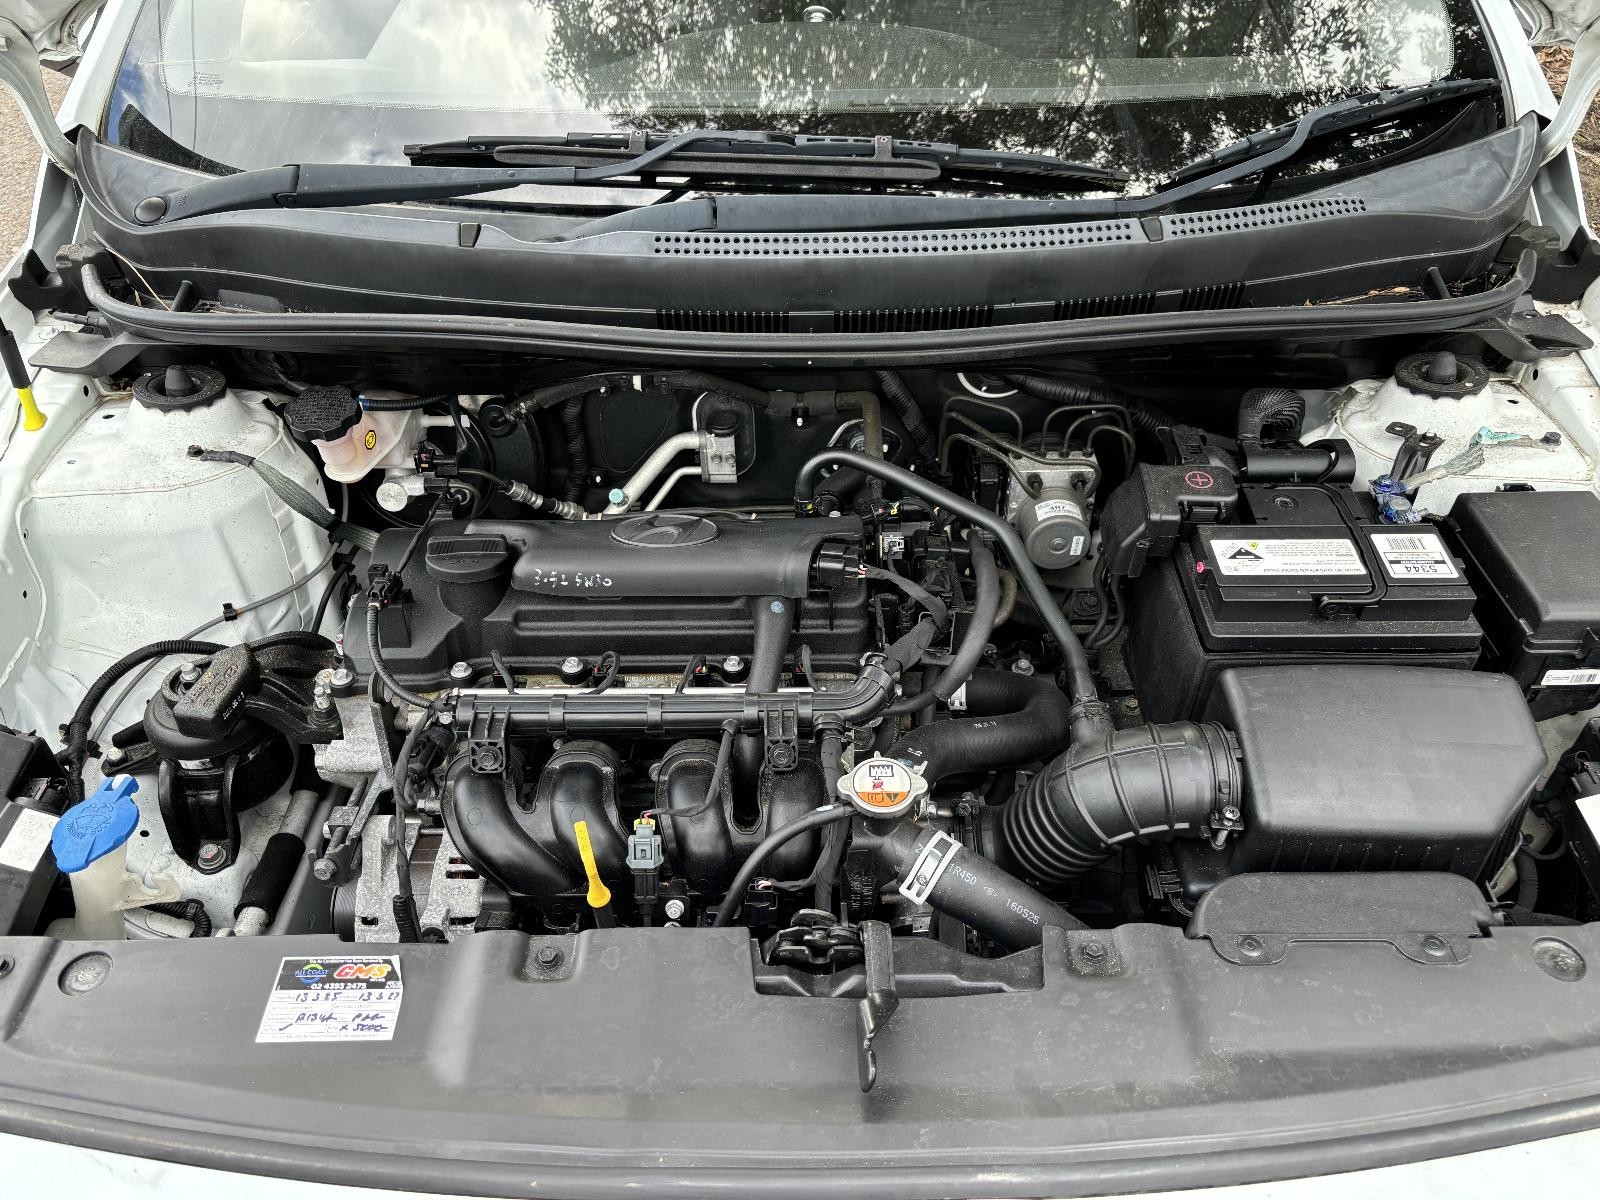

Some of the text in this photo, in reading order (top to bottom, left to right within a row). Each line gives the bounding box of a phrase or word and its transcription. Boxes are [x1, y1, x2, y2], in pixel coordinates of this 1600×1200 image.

[1404, 565, 1438, 573] 5344
[1005, 898, 1040, 926] 160525
[333, 963, 392, 979] GMS
[310, 982, 367, 990] 02 4393 2475
